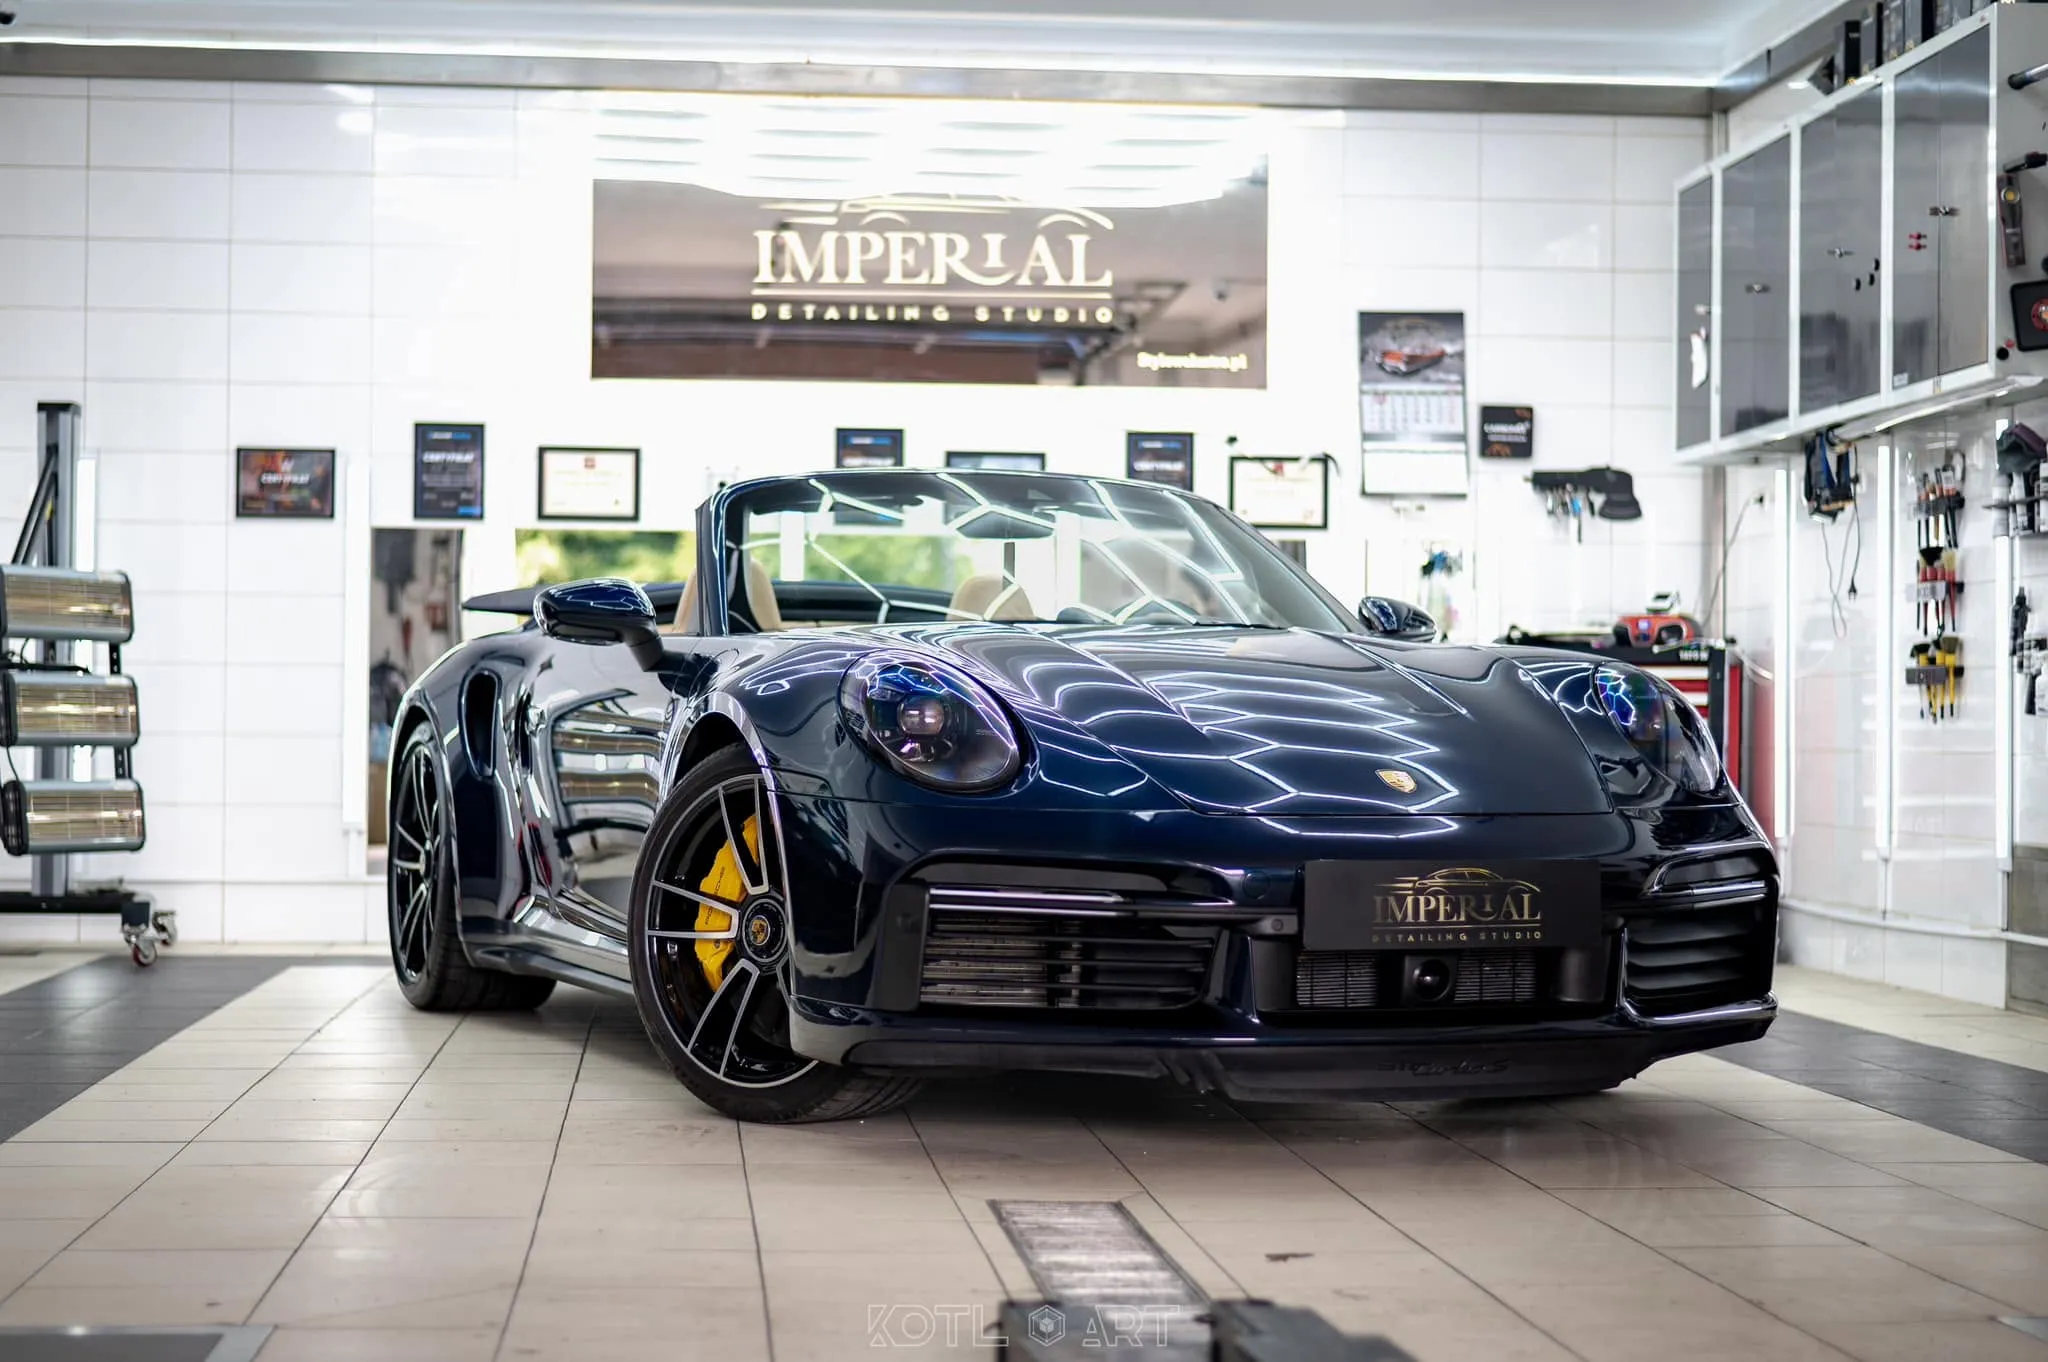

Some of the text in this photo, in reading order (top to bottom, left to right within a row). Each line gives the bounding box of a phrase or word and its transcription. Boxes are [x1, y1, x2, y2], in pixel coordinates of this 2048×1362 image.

[752, 230, 1113, 287] IMPERIAL
[751, 303, 1113, 323] DETAILING STUDIO
[1372, 893, 1541, 923] IMPERIAL
[1372, 931, 1542, 943] DETAILING STUDIO
